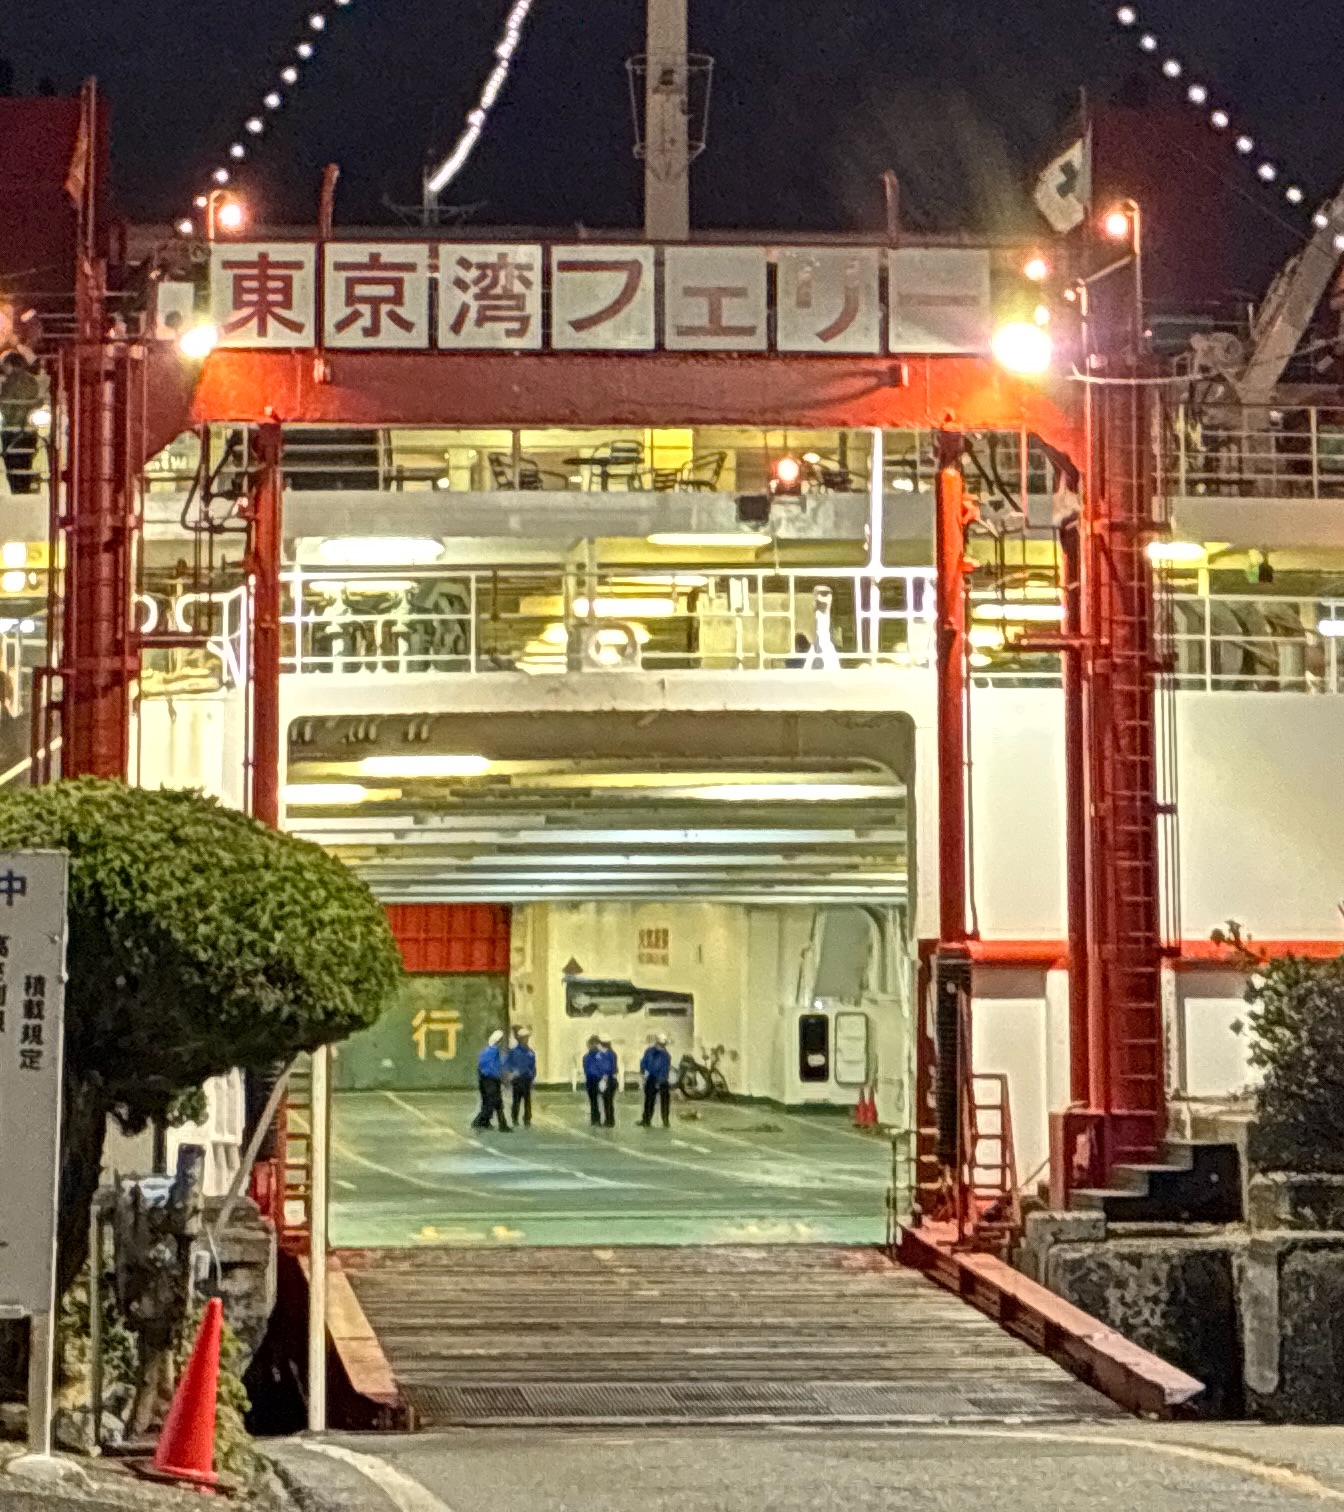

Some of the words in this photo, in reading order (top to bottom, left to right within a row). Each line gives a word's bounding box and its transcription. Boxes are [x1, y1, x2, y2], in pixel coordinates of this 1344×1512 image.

[220, 252, 981, 340] 東京湾フェリー
[411, 1008, 463, 1060] 行
